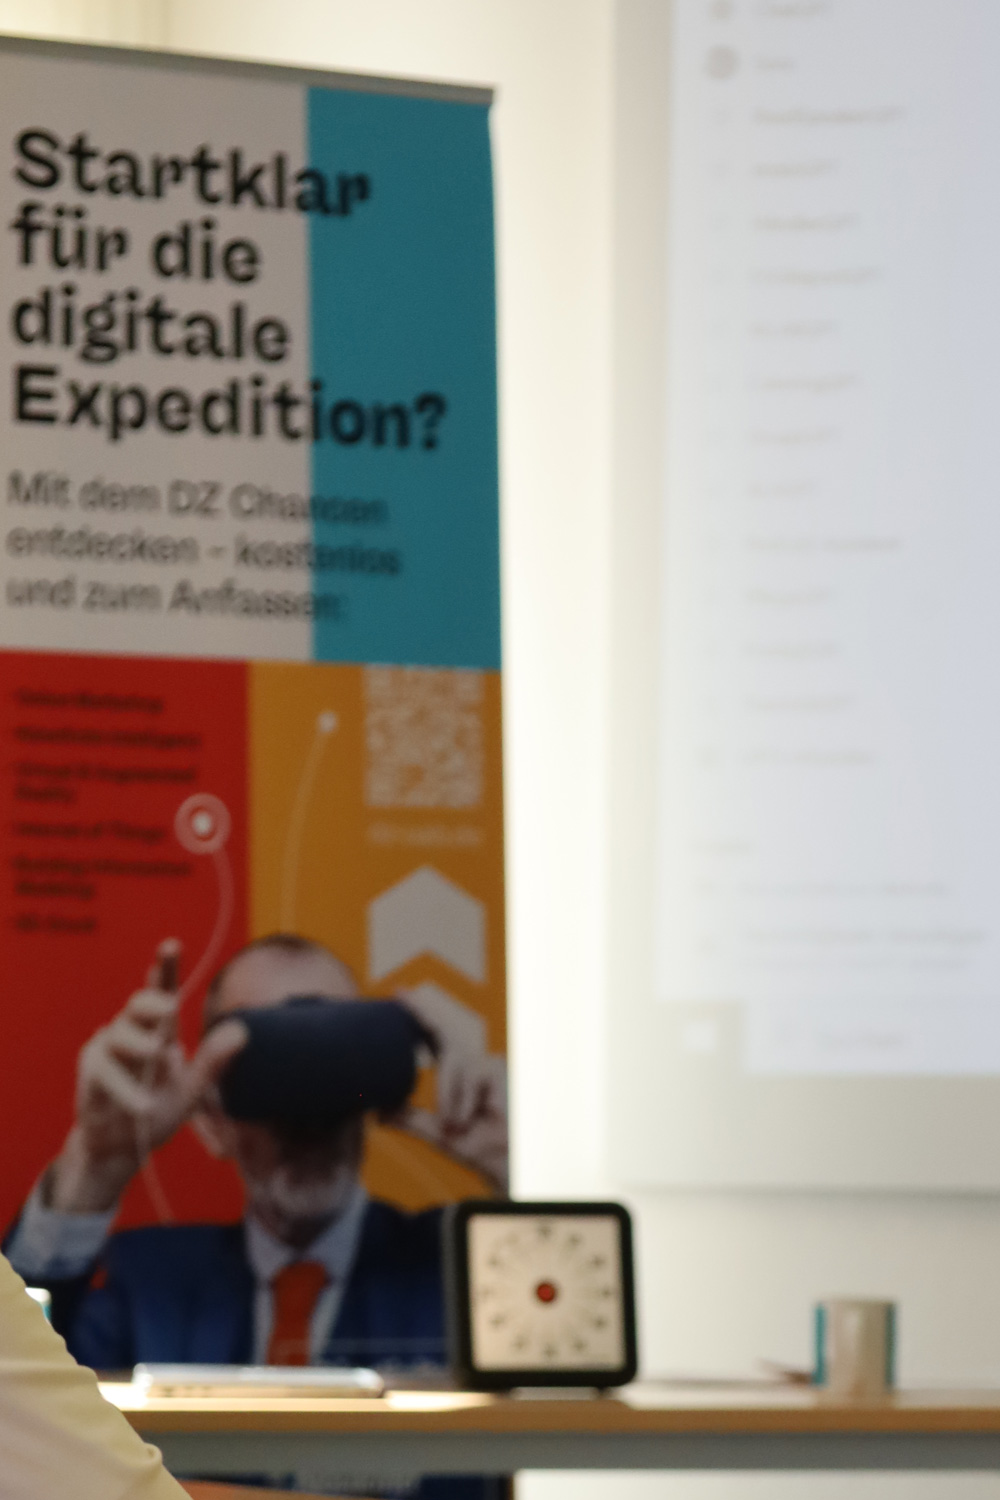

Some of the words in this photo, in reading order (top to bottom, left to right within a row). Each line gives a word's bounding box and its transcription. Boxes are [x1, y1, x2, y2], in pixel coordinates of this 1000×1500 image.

[14, 127, 371, 216] Startklar
[12, 202, 128, 270] für
[152, 216, 260, 284] die
[13, 283, 290, 363] digitale
[14, 365, 447, 451] Expedition?
[7, 470, 71, 507] Mit
[79, 476, 161, 512] dem
[168, 480, 222, 517] DZ
[229, 483, 389, 525] Chancen
[6, 525, 199, 565] entdecken
[234, 535, 402, 576] kostenlos
[5, 576, 75, 608] und
[83, 581, 161, 612] zum
